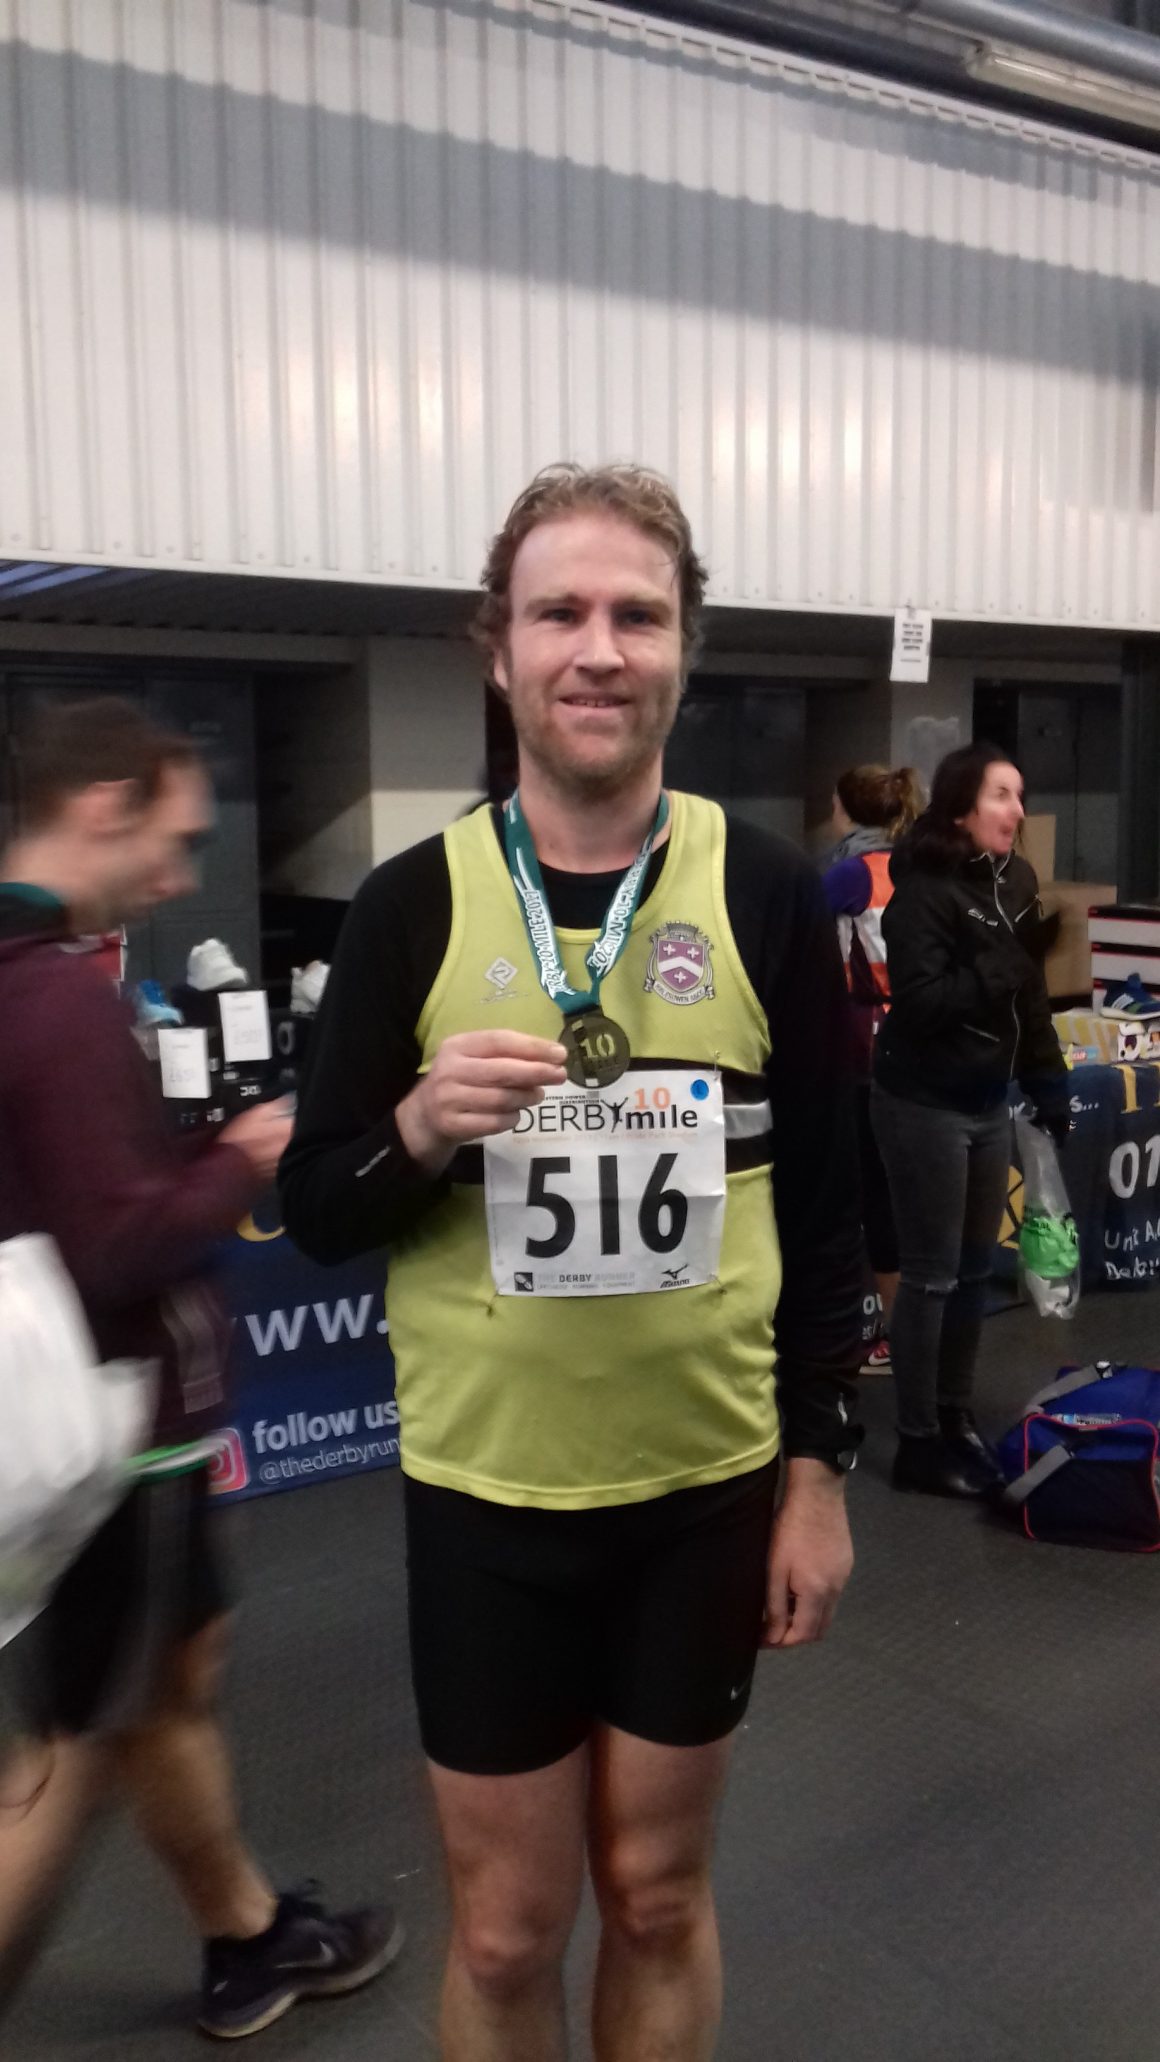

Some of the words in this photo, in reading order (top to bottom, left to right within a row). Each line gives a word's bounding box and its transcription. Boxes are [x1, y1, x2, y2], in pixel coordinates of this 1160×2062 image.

[522, 889, 542, 916] 2017
[529, 918, 551, 948] MILE
[579, 1033, 615, 1059] 10
[633, 1087, 671, 1110] 10
[625, 1104, 698, 1129] mile
[525, 1152, 688, 1259] 516
[559, 1273, 592, 1283] DERBY
[252, 1408, 358, 1453] follow
[364, 1401, 400, 1430] us
[259, 1437, 401, 1484] @thederbyrun
